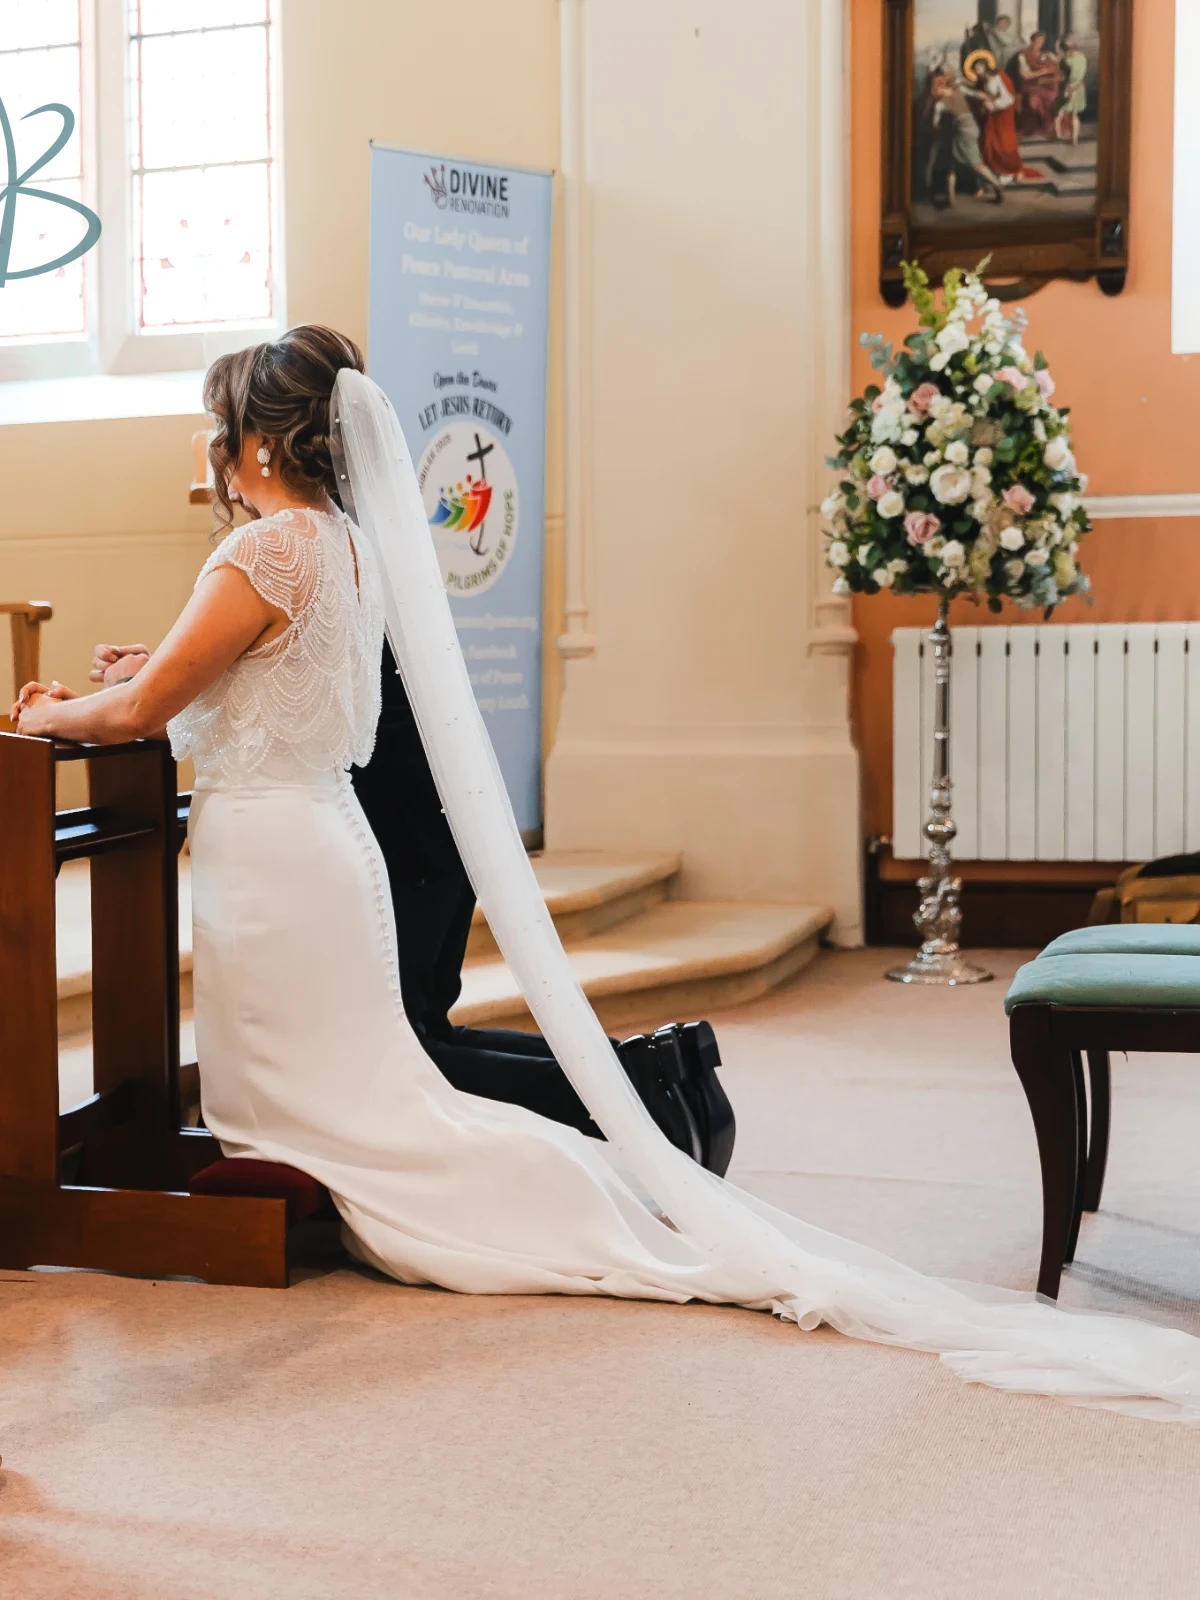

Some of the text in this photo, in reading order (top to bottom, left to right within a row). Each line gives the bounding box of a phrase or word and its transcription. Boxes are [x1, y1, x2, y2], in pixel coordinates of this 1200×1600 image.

[450, 169, 509, 202] DIVINE
[450, 197, 510, 219] RENOVATION
[418, 395, 513, 437] LET JESUS RETURN
[446, 488, 514, 591] PILGRIMS OF HOPE
